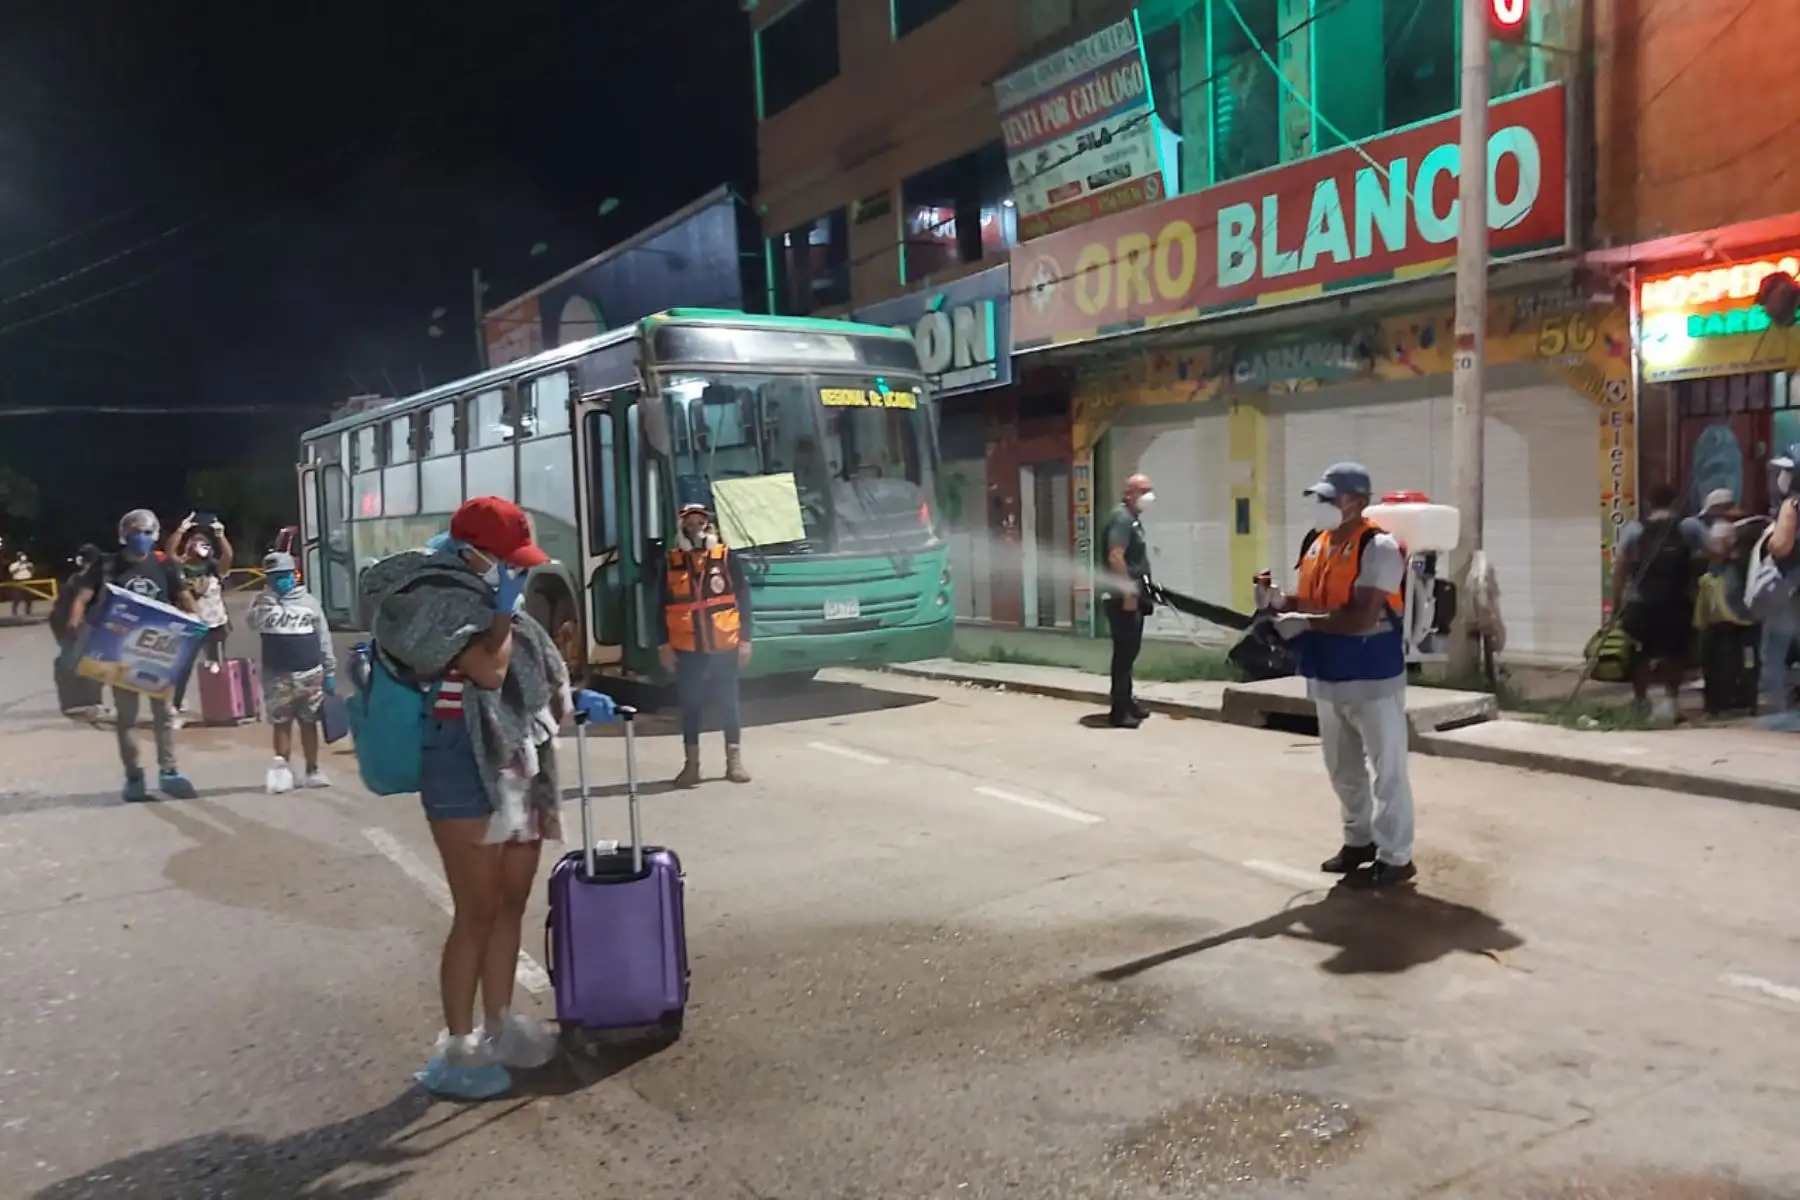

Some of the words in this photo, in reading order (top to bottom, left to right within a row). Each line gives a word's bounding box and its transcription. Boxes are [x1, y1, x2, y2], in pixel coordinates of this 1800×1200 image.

[1074, 220, 1197, 315] ORO
[1217, 126, 1541, 288] BLANCO
[915, 293, 996, 375] ÓN
